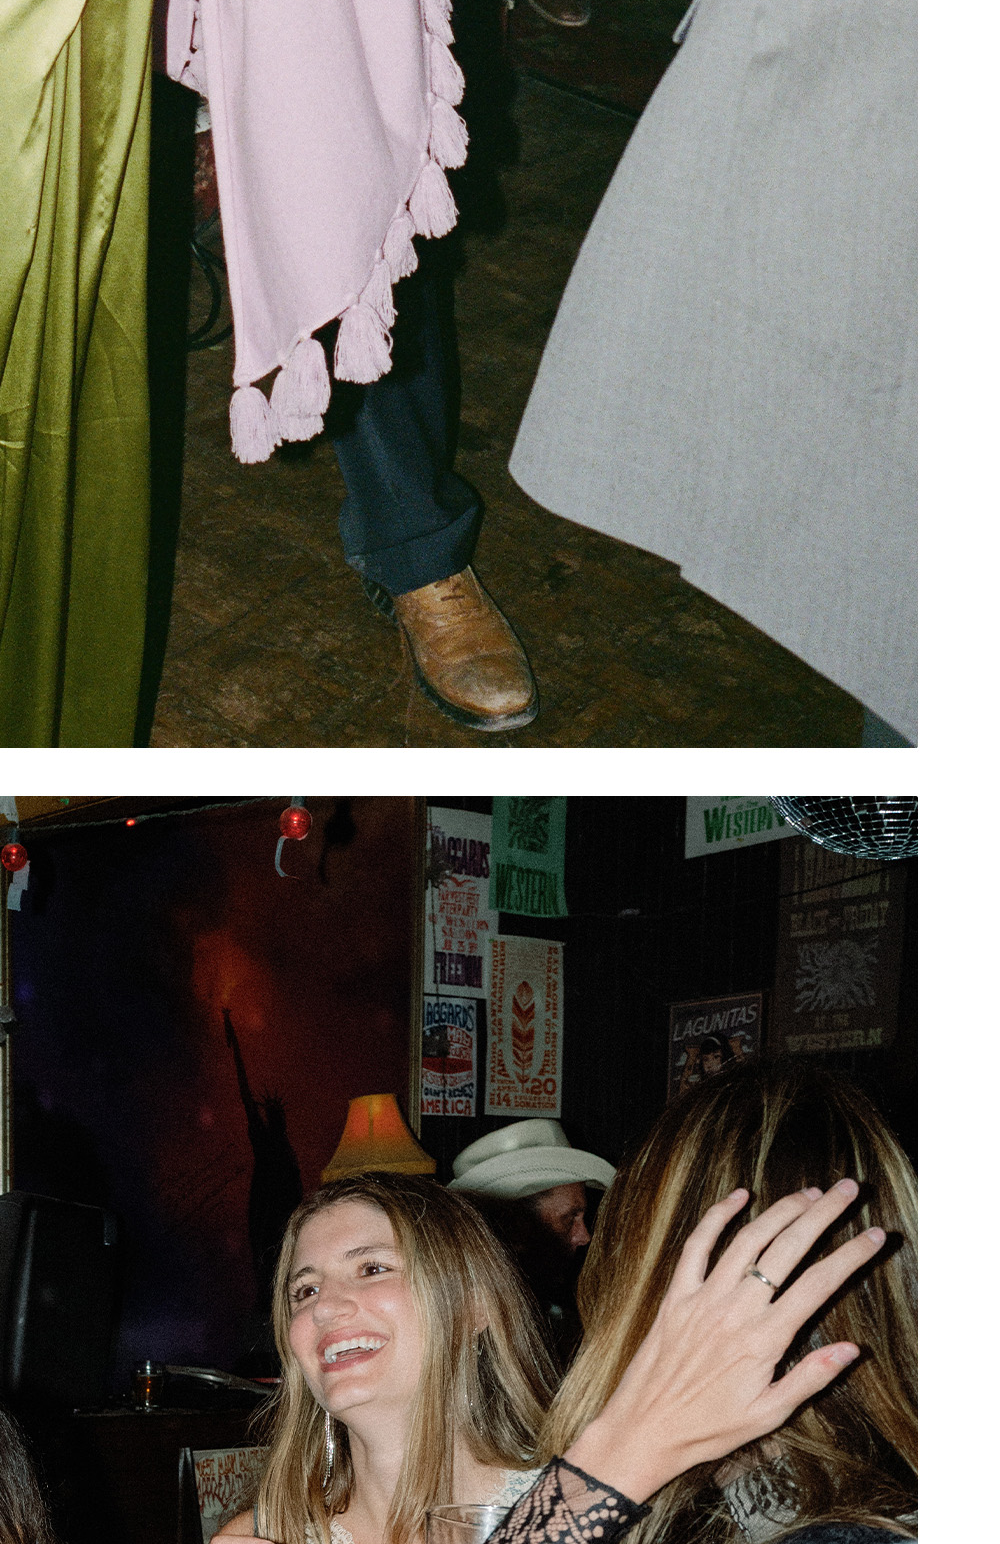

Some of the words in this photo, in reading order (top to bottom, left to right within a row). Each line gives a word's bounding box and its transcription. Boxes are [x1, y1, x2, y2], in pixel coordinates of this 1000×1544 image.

[495, 862, 560, 916] WESTERN
[424, 1002, 475, 1033] AGGARDS
[673, 1004, 758, 1042] LAGUNITAS
